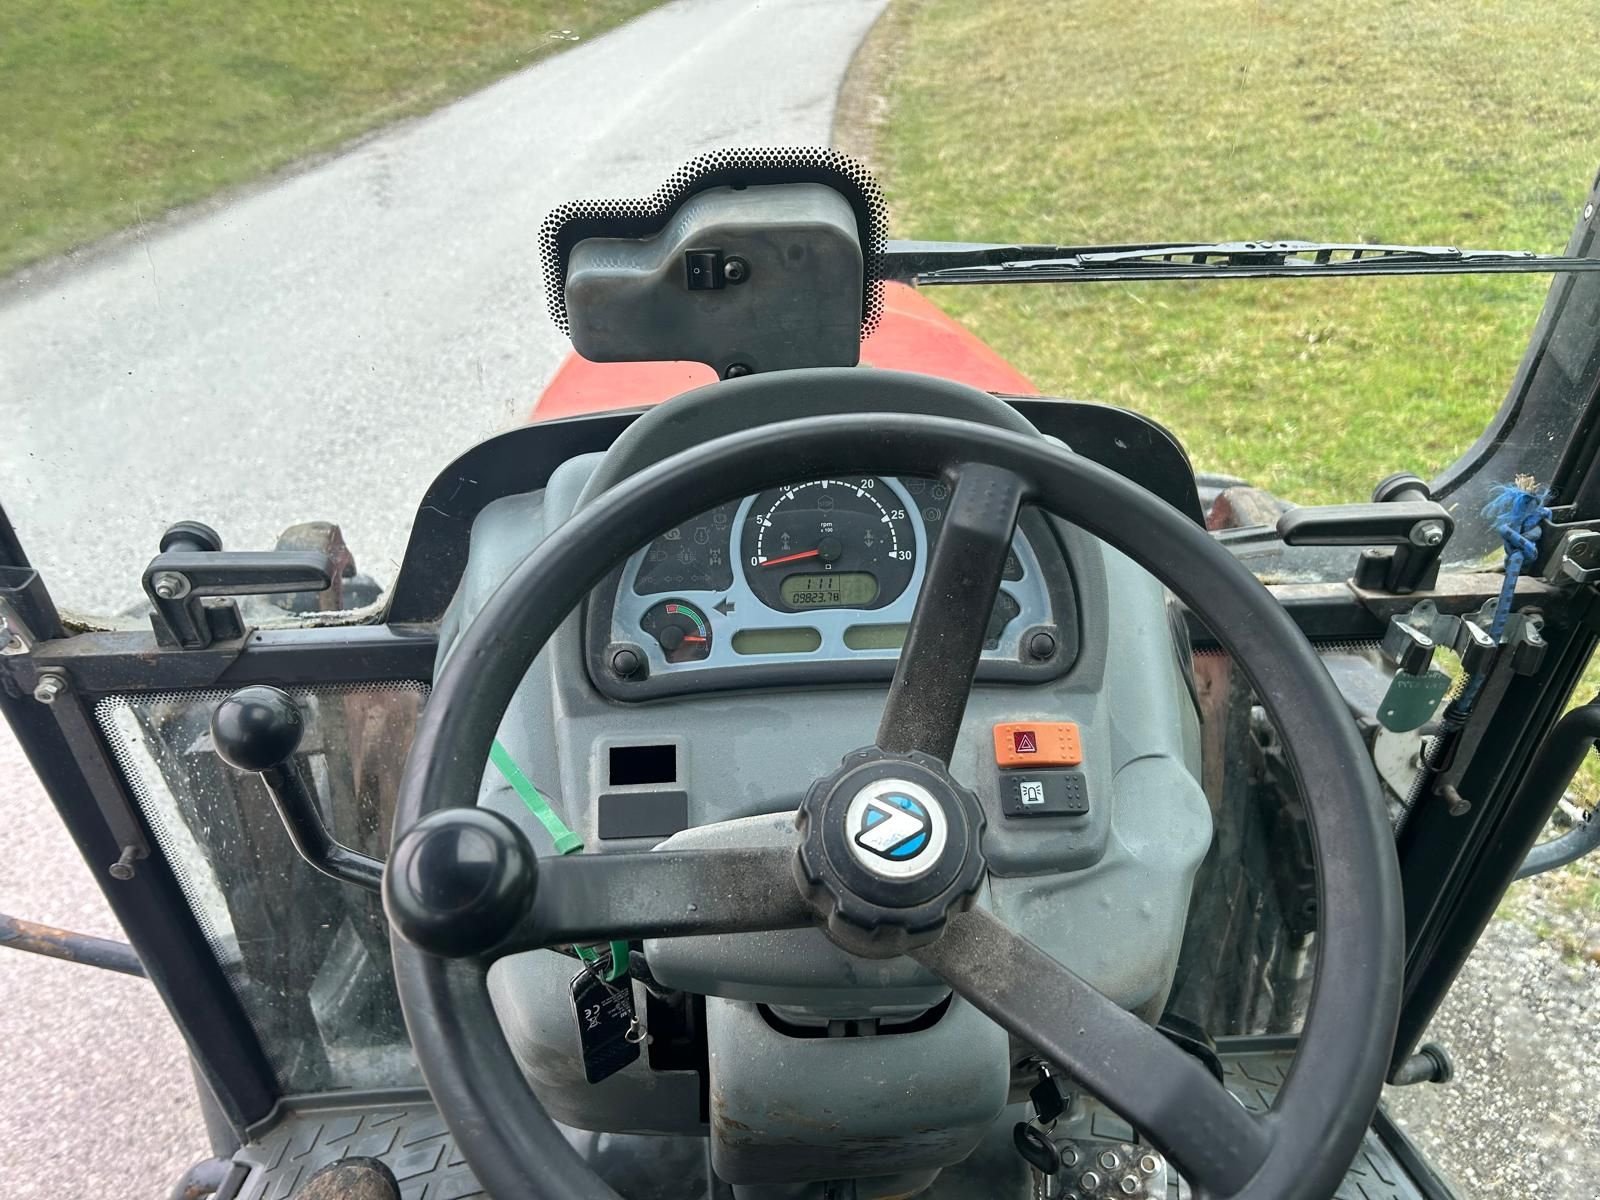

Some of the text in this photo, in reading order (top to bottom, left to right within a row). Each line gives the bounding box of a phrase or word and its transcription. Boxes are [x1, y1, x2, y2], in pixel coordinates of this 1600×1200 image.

[861, 479, 874, 489] 20
[756, 515, 763, 525] 5
[891, 510, 905, 520] 25
[898, 551, 912, 560] 30
[751, 557, 758, 566] 0
[793, 592, 840, 604] 09823.78
